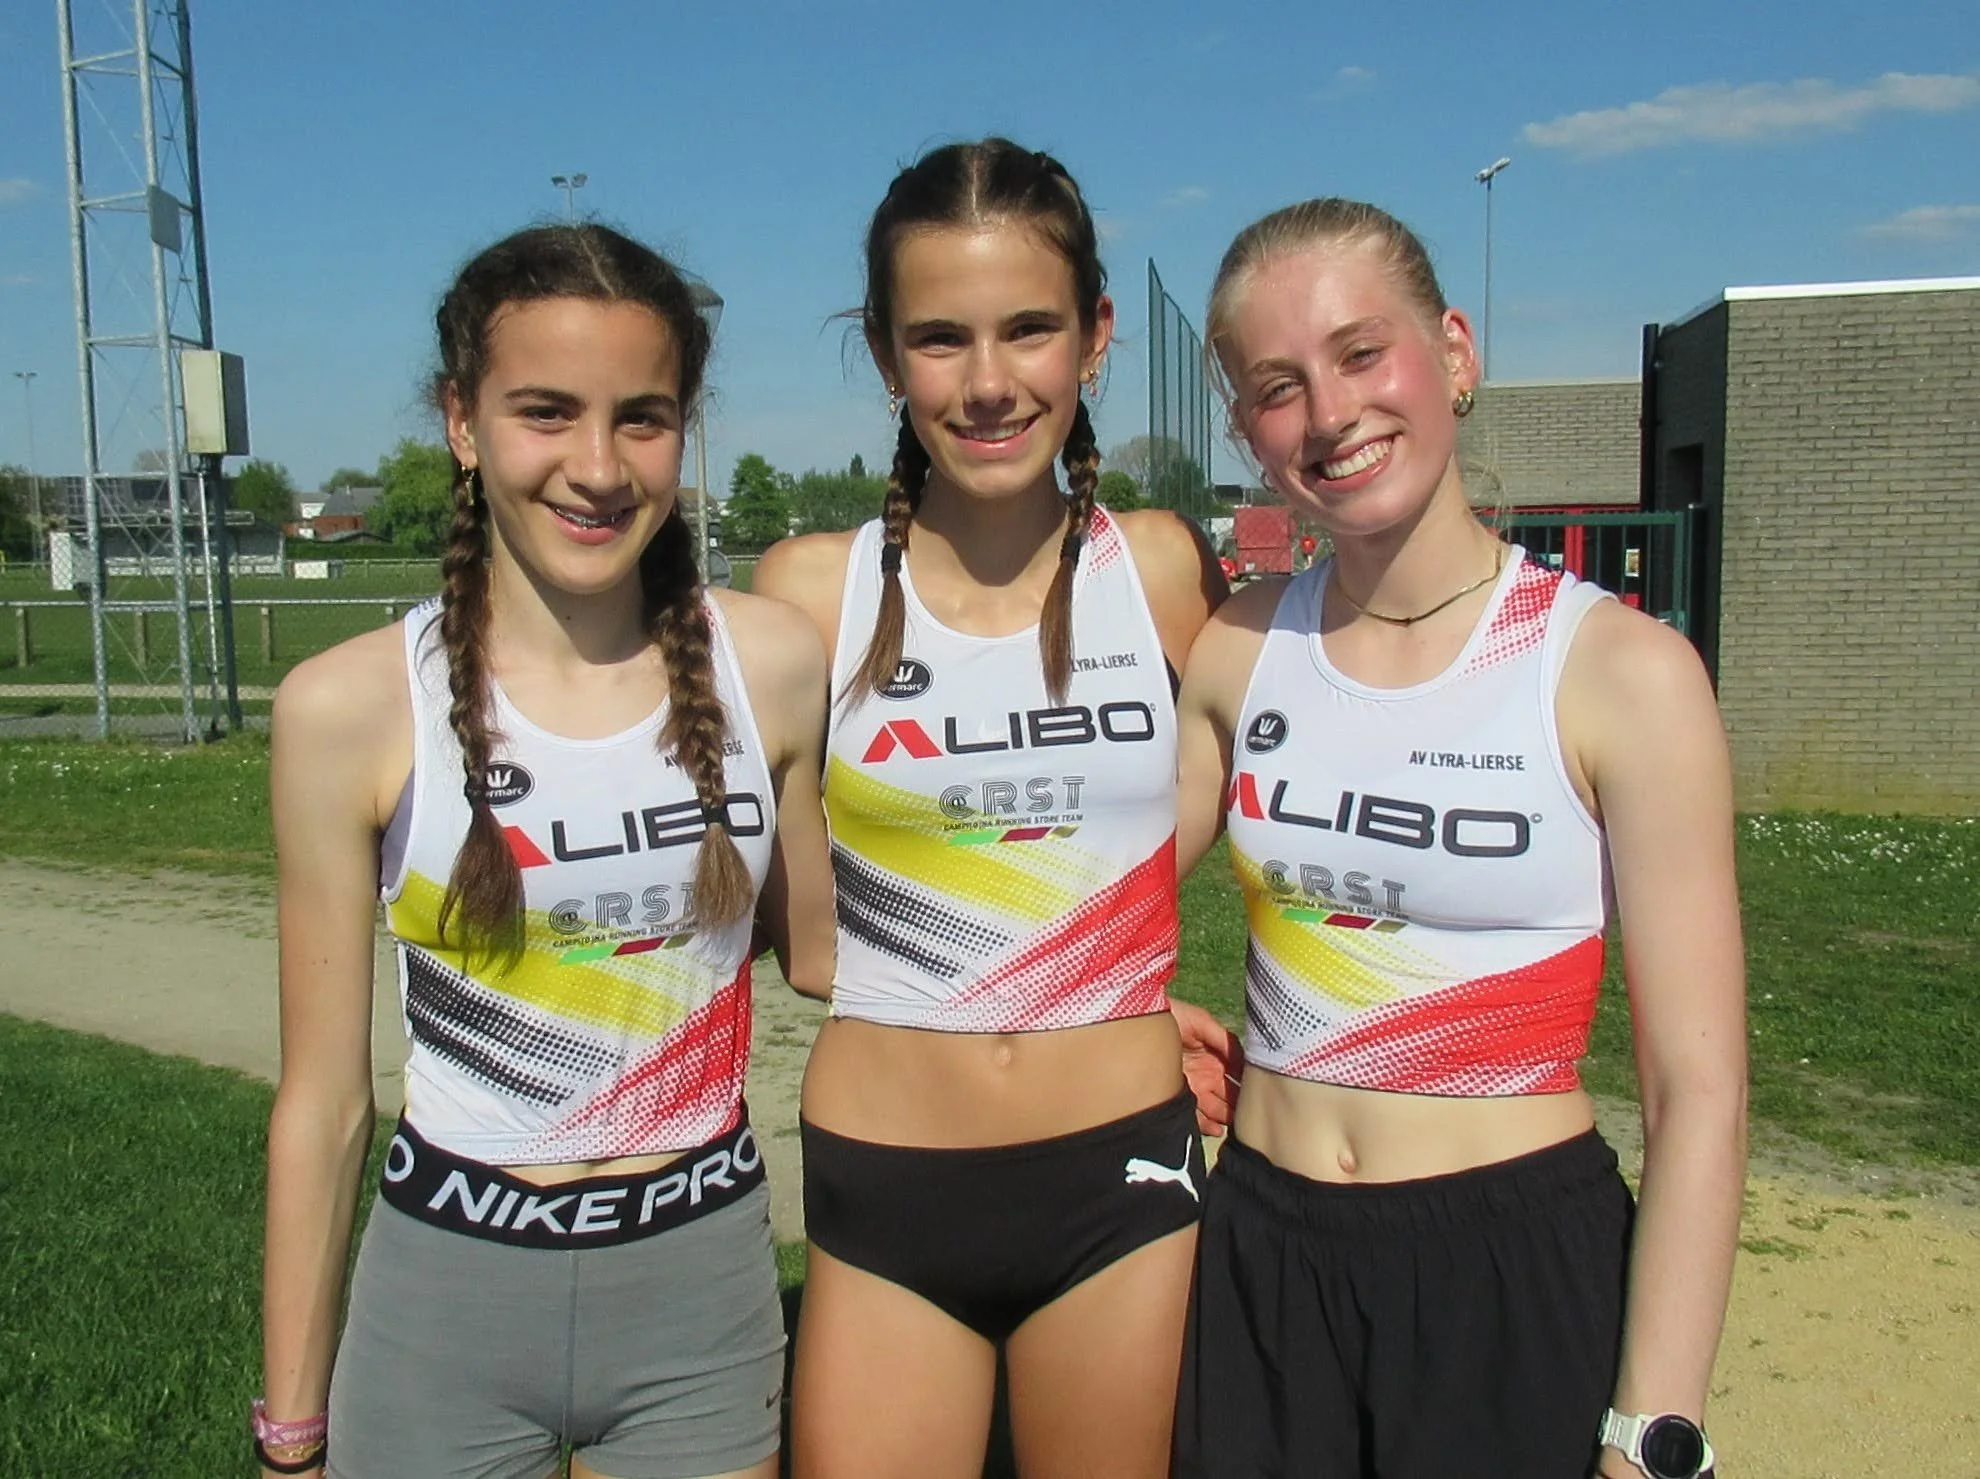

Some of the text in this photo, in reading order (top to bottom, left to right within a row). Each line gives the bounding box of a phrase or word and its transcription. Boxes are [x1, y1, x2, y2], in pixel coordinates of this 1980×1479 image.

[861, 701, 1154, 764] ALIBO
[1409, 750, 1525, 771] AV LYRA-LIERSE
[1035, 815, 1059, 825] STORE
[1062, 814, 1084, 823] TEAM
[1227, 771, 1531, 858] ALIBO
[428, 1169, 627, 1234] NIKE
[638, 1127, 760, 1225] PRO
